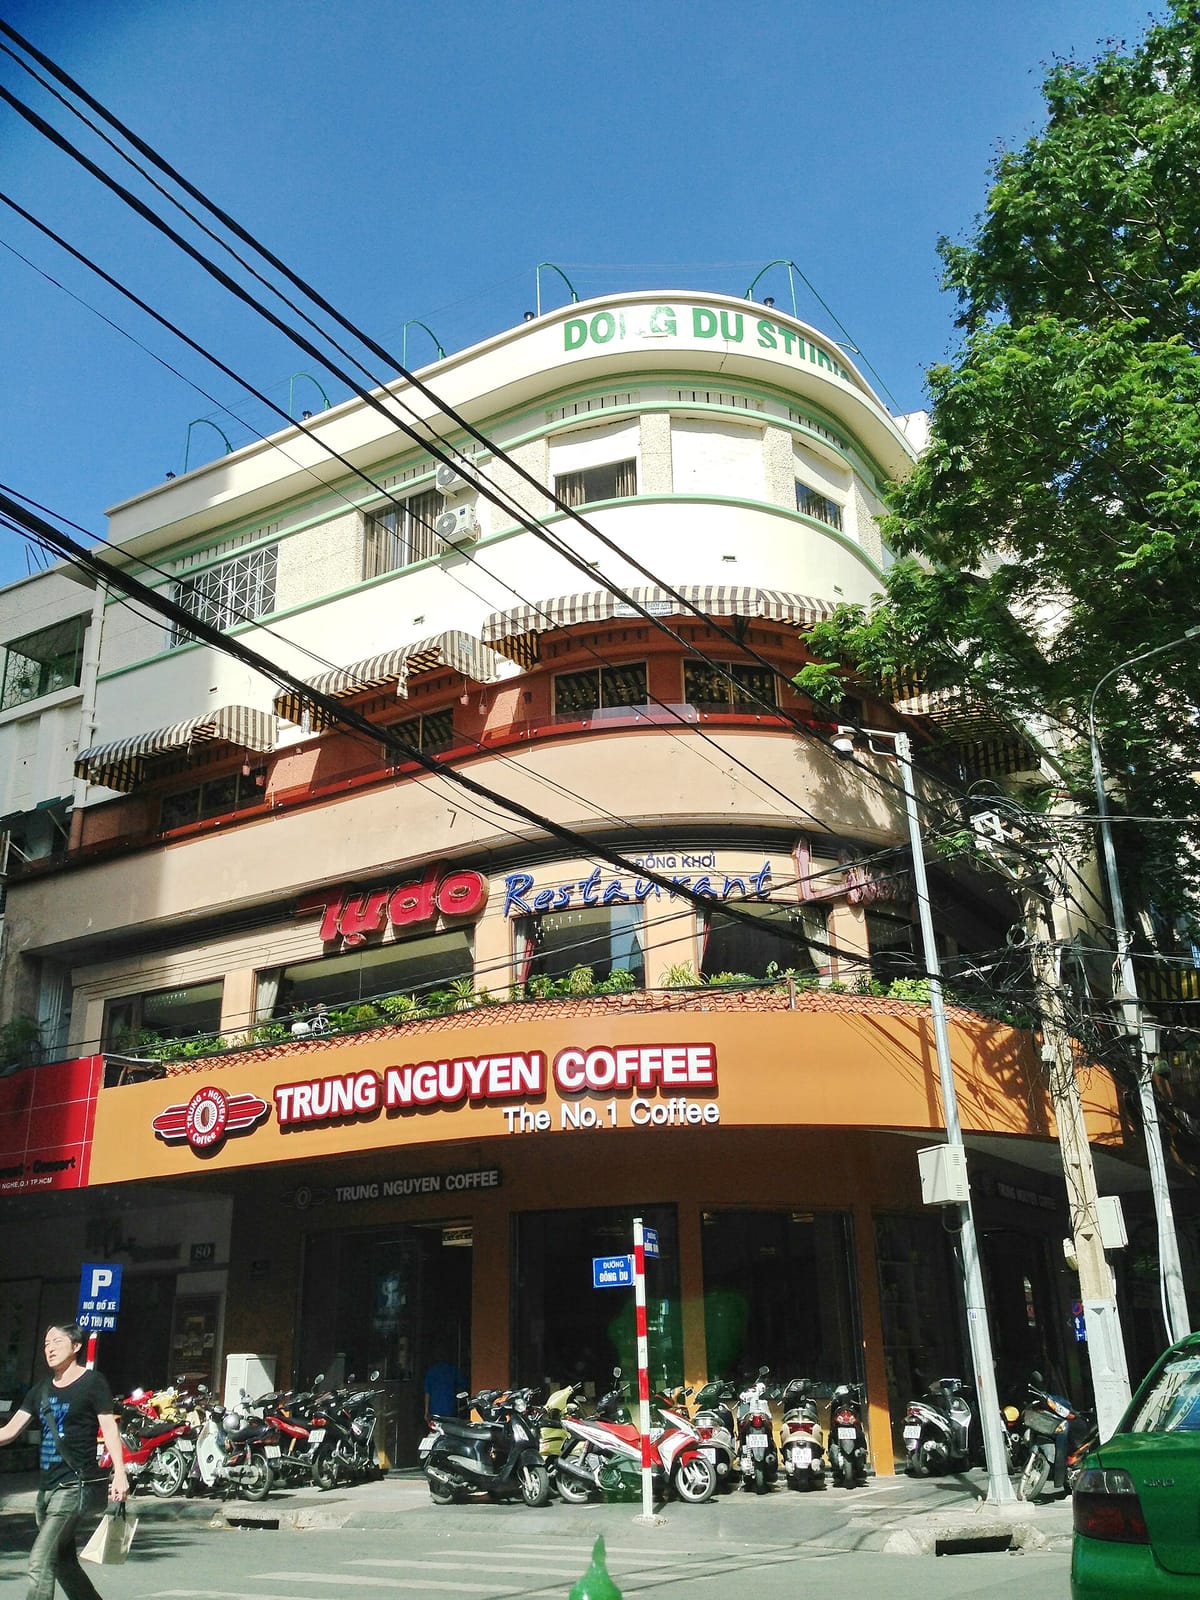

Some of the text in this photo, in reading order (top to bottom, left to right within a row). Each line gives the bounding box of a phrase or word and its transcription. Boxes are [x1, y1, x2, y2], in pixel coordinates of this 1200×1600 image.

[692, 307, 744, 343] DU
[275, 1047, 714, 1120] TRUNG NGUYEN COFFEE
[186, 1089, 226, 1129] TRUNG NGUYEN
[502, 1097, 721, 1133] The No.1 Coffee
[191, 1131, 217, 1146] Coffee
[335, 1170, 499, 1202] TRUNG NGUYEN COFFEE
[91, 1269, 113, 1298] P
